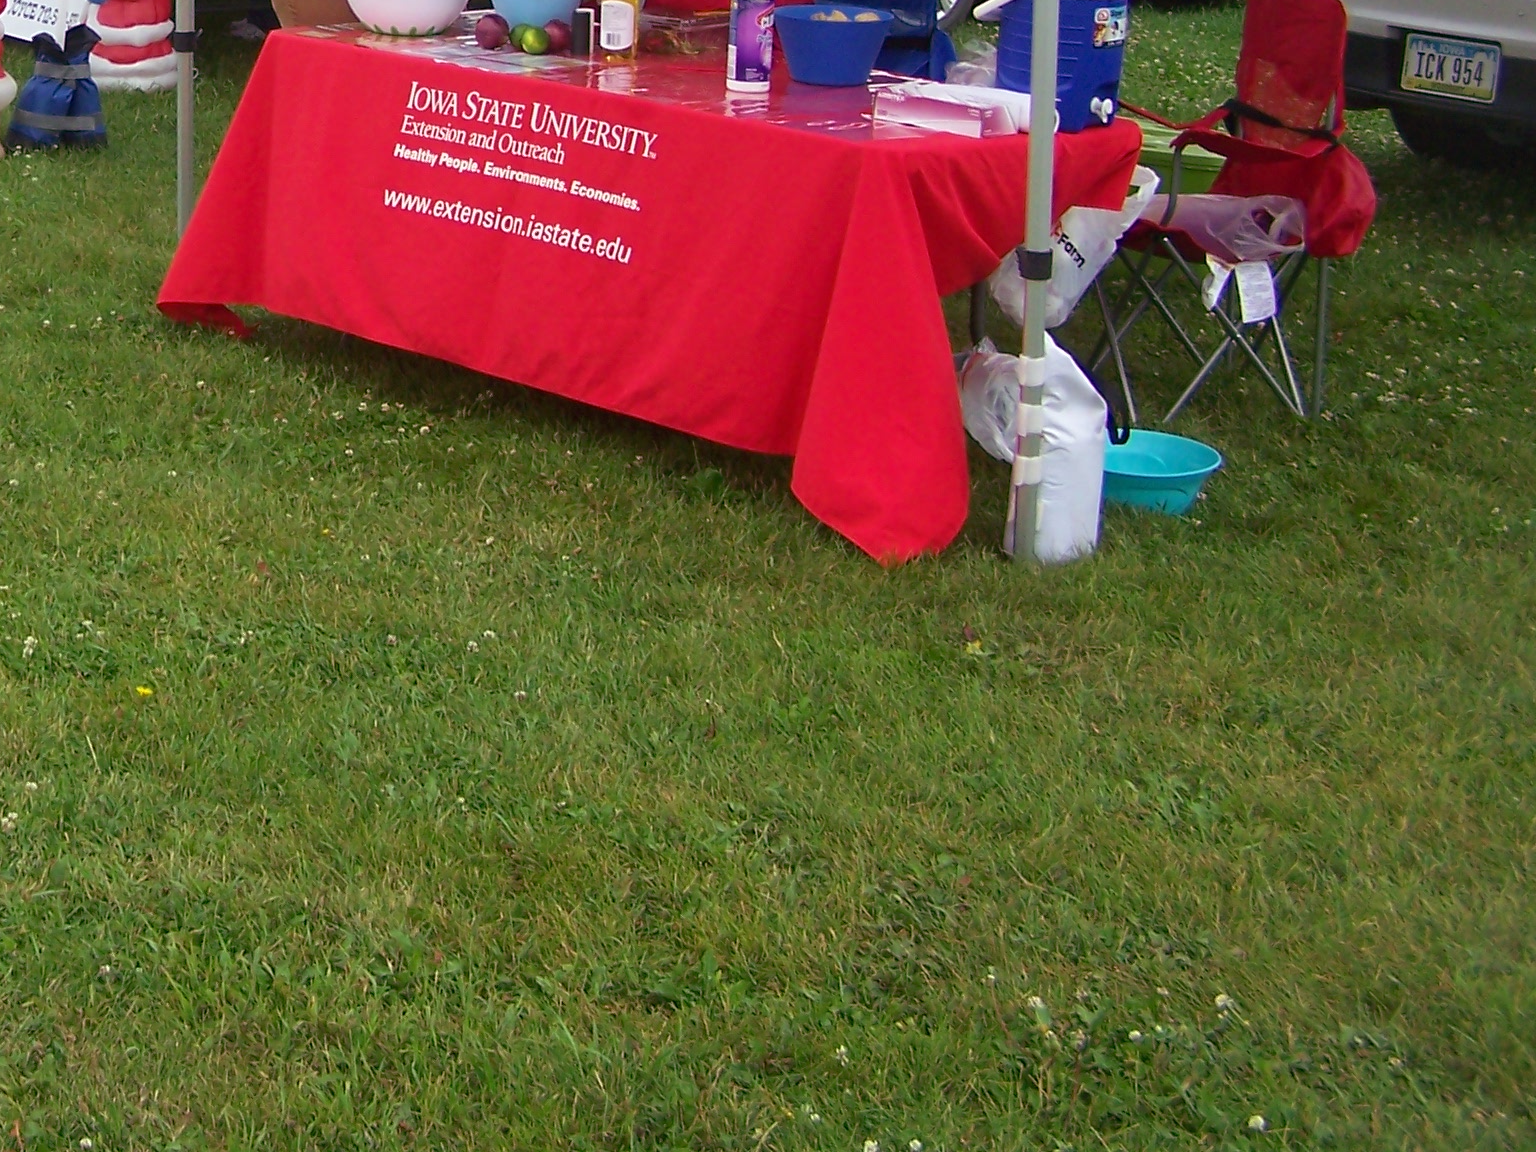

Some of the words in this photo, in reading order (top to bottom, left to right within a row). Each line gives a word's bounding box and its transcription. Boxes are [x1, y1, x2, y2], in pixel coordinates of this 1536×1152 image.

[1414, 51, 1447, 82] ICK
[1451, 57, 1484, 88] 954
[400, 114, 466, 145] Extension
[468, 129, 498, 151] and
[498, 133, 566, 165] Outreach
[406, 80, 459, 117] IOWA
[462, 90, 526, 130] STATE
[530, 102, 659, 158] UNIVERSITY
[393, 143, 439, 167] Healthy
[438, 153, 481, 174] People.
[483, 161, 568, 194] Environments.
[569, 180, 641, 212] Economies.
[383, 188, 633, 264] www.extension.iastate.edu
